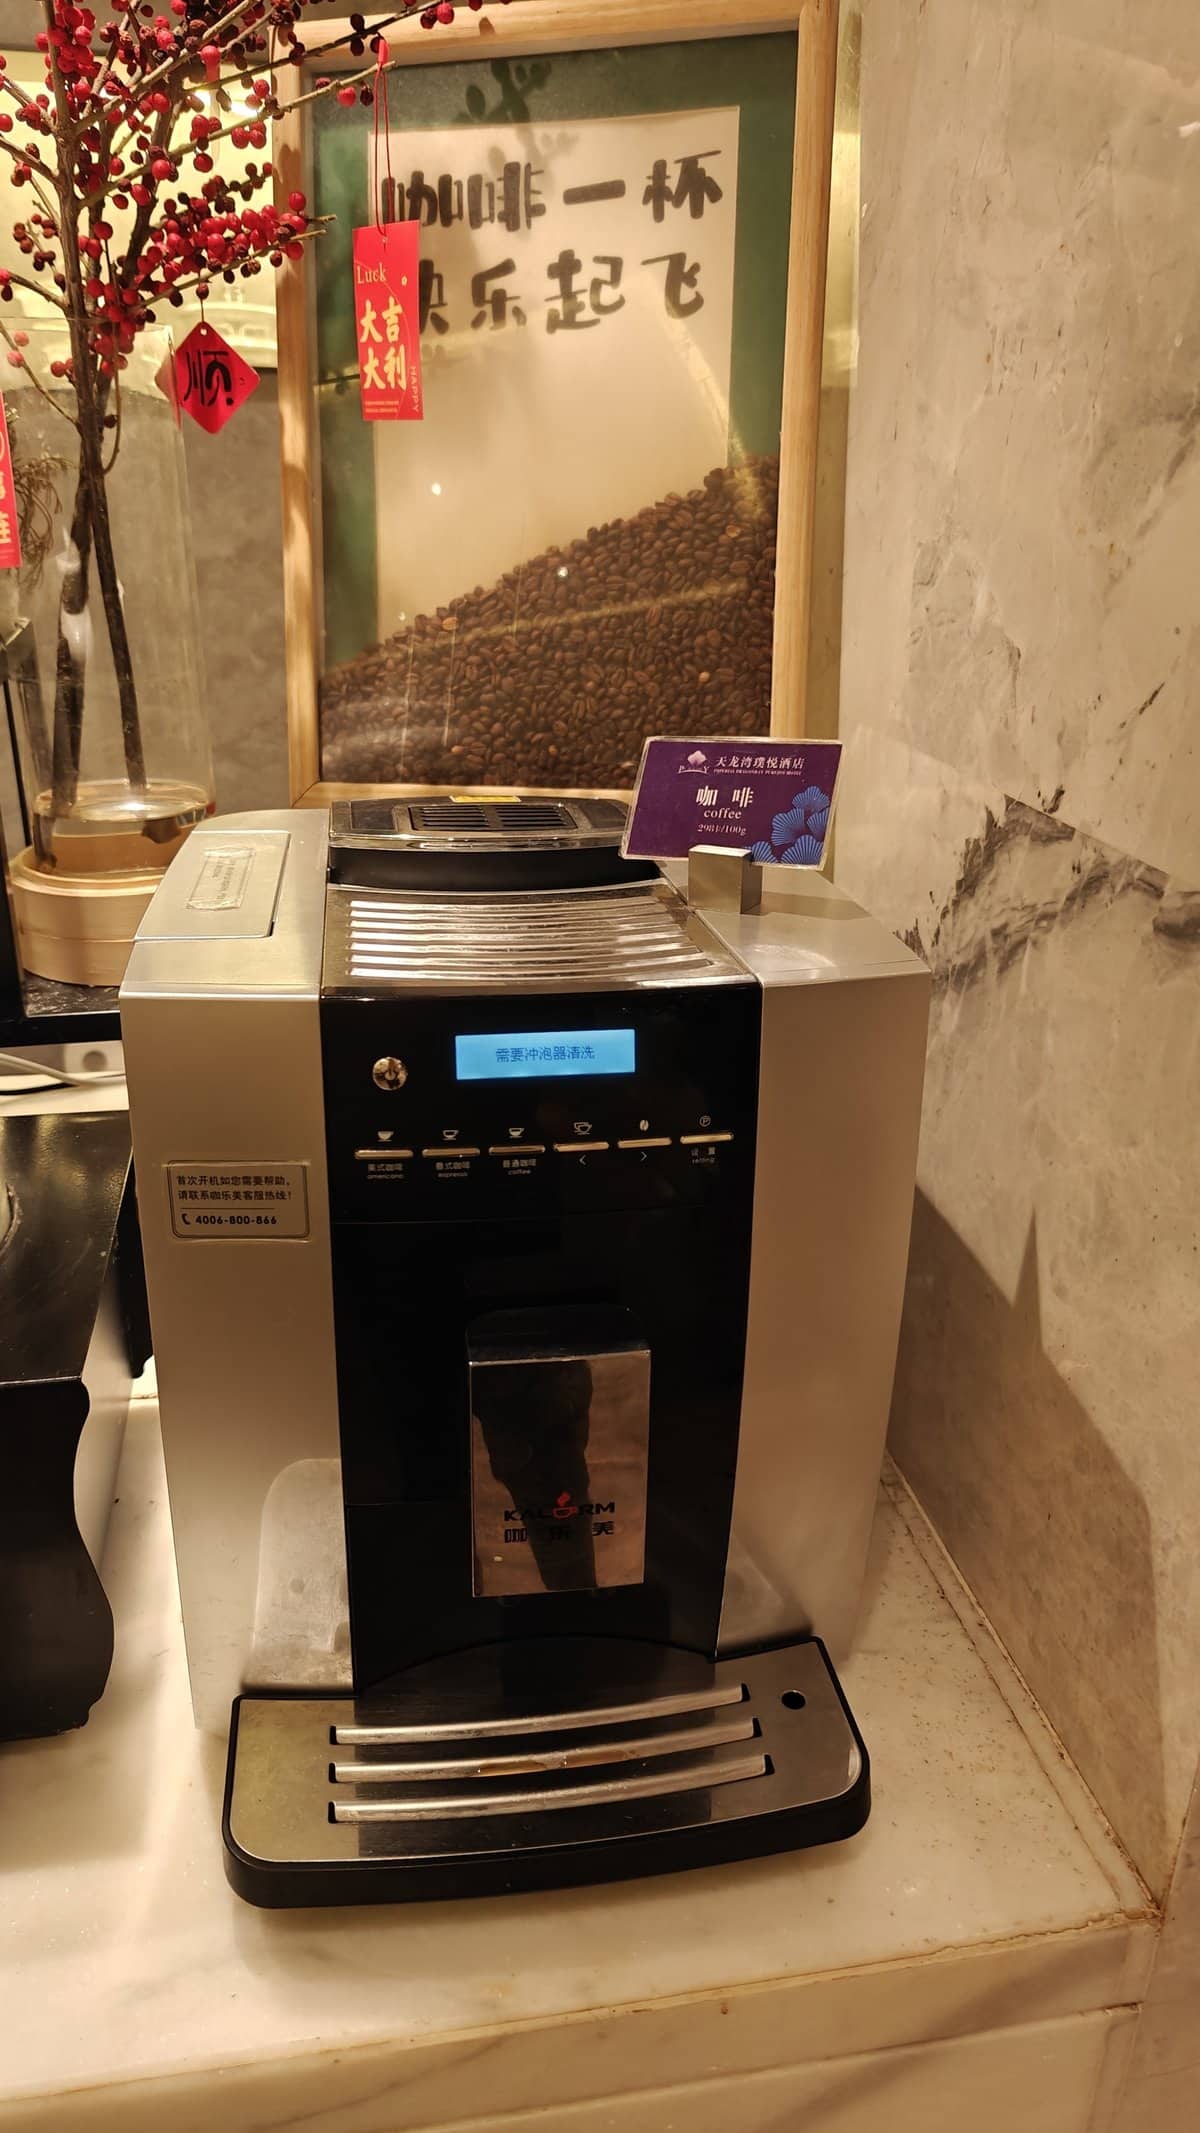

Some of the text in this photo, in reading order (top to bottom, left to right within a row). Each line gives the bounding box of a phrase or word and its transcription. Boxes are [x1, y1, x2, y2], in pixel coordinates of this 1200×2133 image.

[381, 150, 723, 233] 咖啡一杯
[356, 262, 387, 284] Luck
[360, 295, 403, 343] 大吉
[183, 350, 234, 407] 顺
[362, 344, 407, 391] 大利
[408, 365, 420, 413] HAPPY
[717, 756, 805, 770] 天龙湾璞悦酒店
[696, 786, 753, 808] 咖啡
[703, 808, 742, 820] coffee
[495, 1046, 596, 1063] 需要冲泡器清洗
[195, 1215, 277, 1225] 4006-800-866
